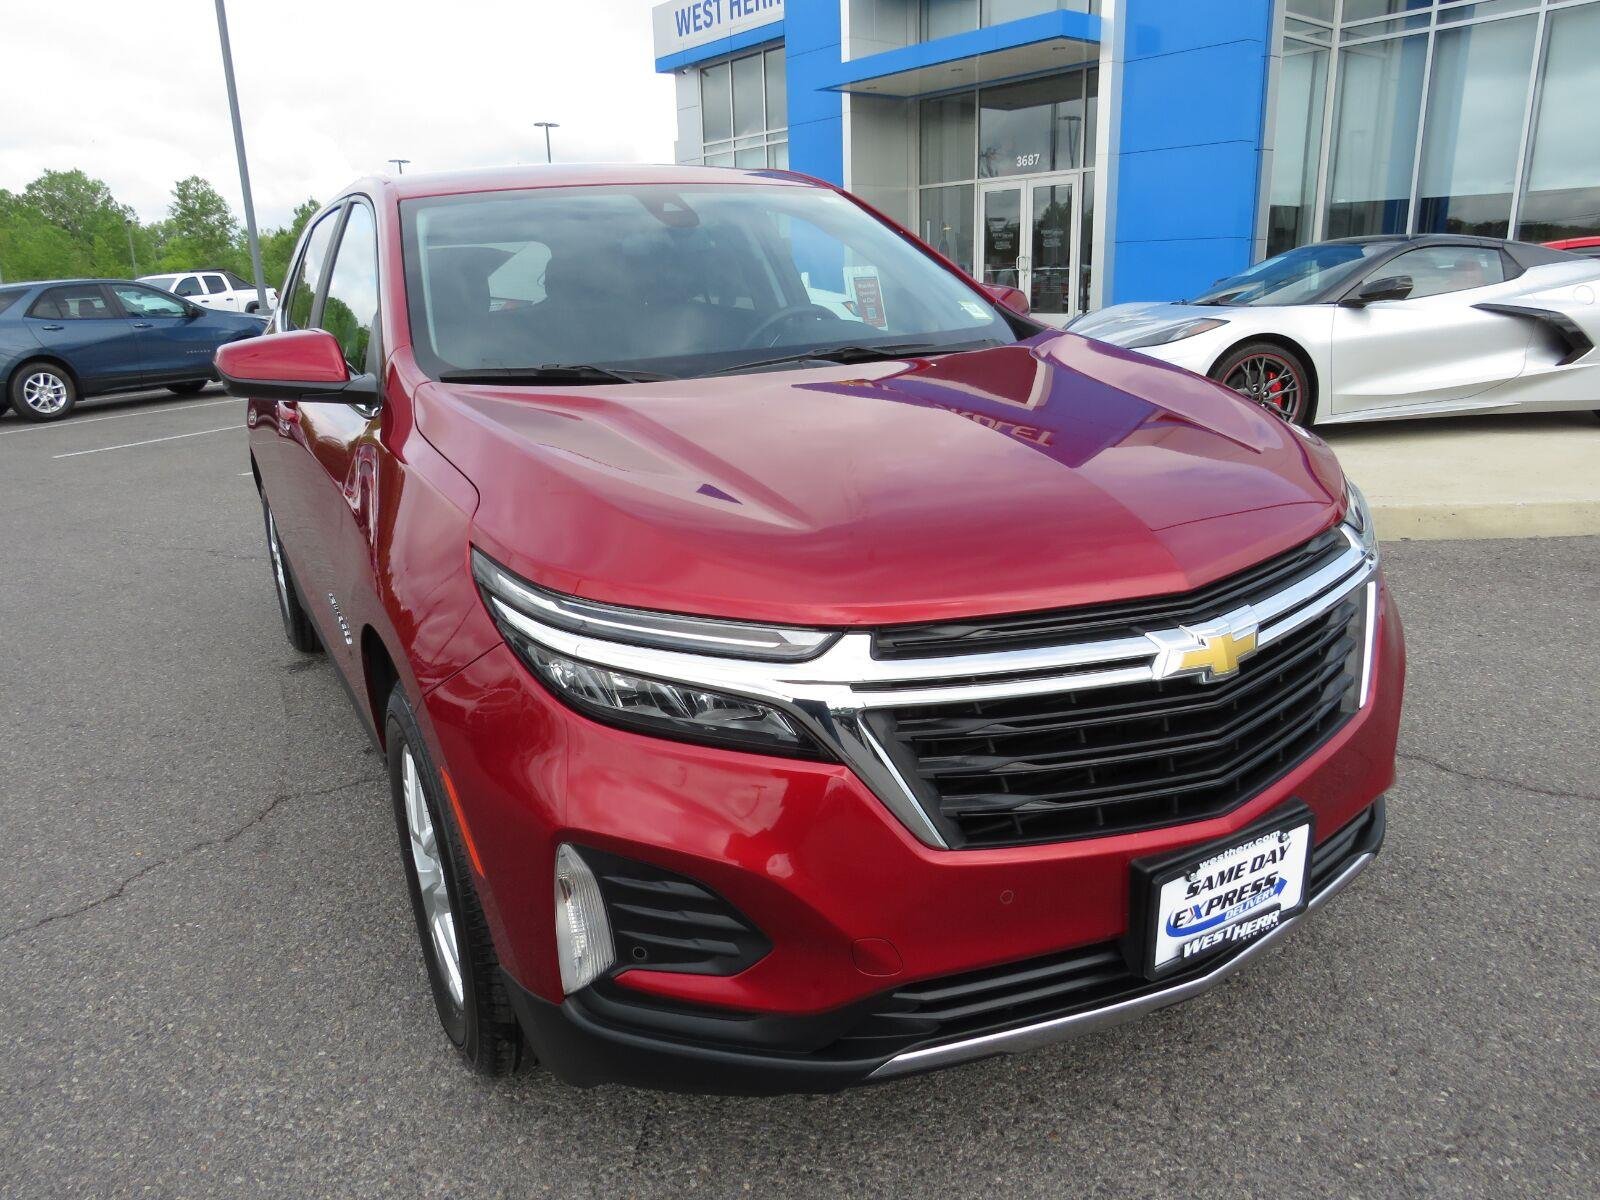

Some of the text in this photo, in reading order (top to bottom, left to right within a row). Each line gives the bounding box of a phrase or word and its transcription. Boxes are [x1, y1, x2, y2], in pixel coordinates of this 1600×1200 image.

[675, 0, 721, 37] WEST
[1016, 153, 1040, 167] 3687
[1185, 842, 1292, 900] SAME DAY
[1173, 871, 1279, 928] EXPRESS
[1225, 887, 1278, 921] DELIVERY
